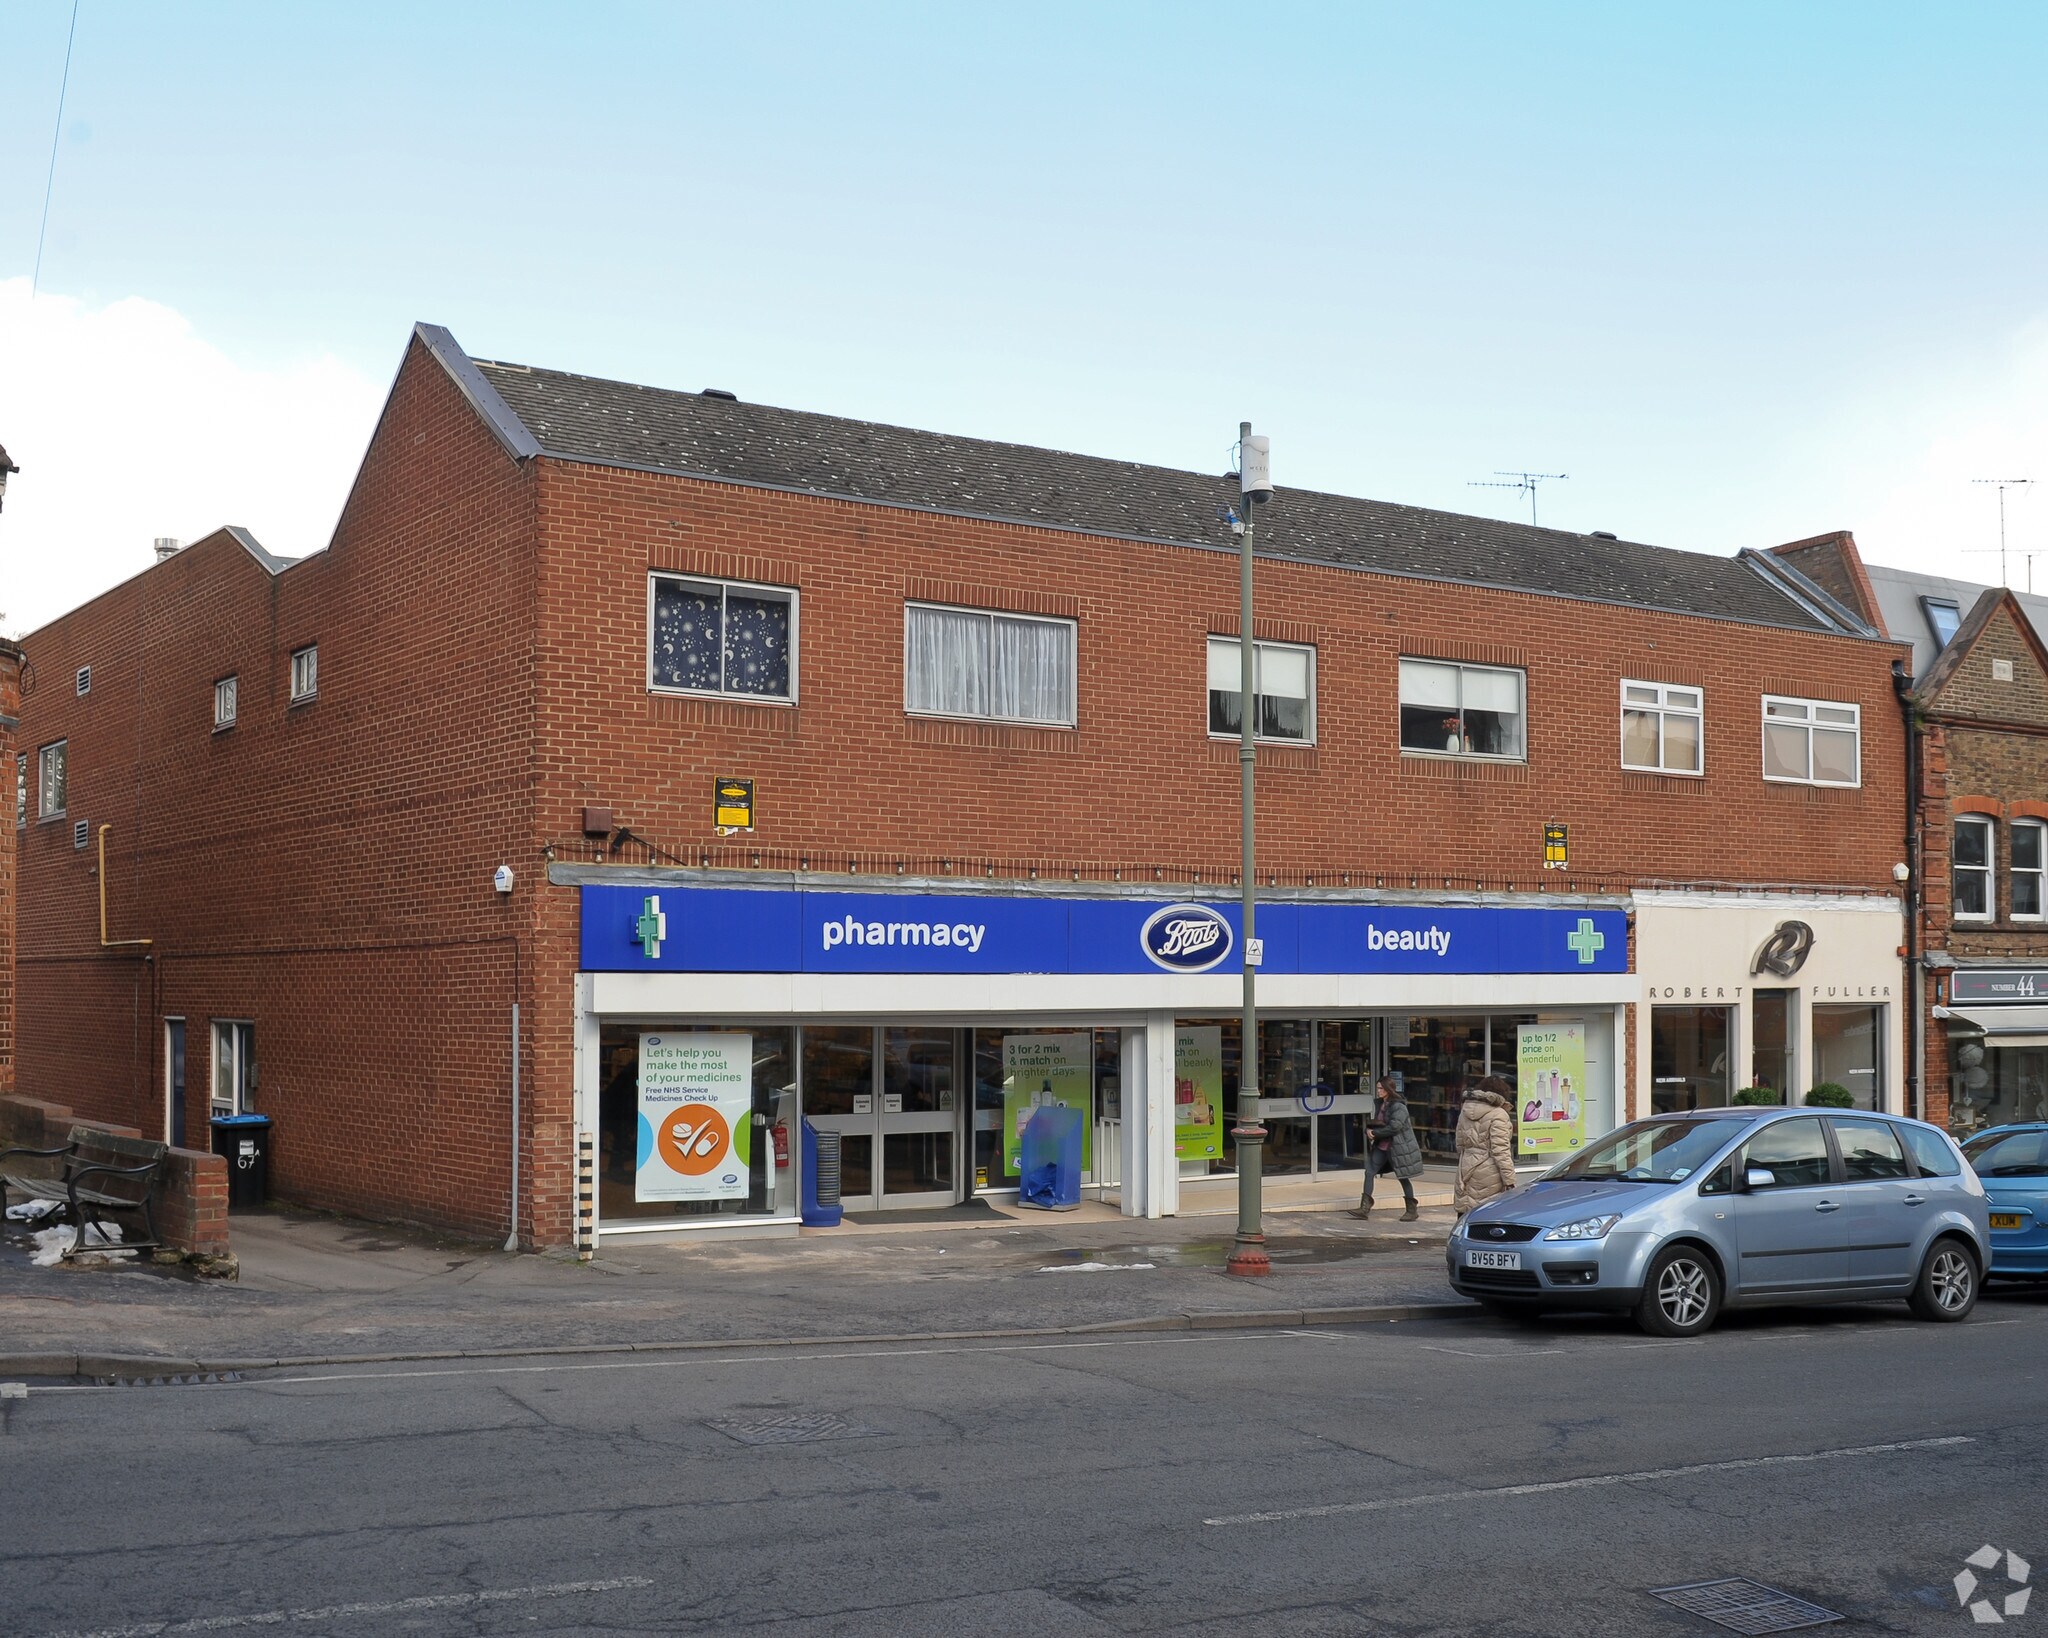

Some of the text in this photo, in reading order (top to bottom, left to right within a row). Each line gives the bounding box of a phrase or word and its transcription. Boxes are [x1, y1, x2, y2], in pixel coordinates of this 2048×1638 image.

[823, 915, 986, 953] pharmacy
[1157, 919, 1220, 956] Boots
[1367, 924, 1451, 956] beauty
[1991, 975, 2035, 996] NUMBER 44
[1649, 986, 1890, 998] ROBERT FULLER
[1178, 1036, 1194, 1046] mix
[1522, 1033, 1557, 1044] up to 1/2
[646, 1047, 722, 1060] Let's help you
[1009, 1043, 1061, 1055] 3 for 2 mix
[1187, 1048, 1200, 1057] on
[1522, 1044, 1555, 1054] price on
[1009, 1055, 1067, 1066] & match on
[1183, 1058, 1214, 1069] beauty
[1521, 1054, 1562, 1064] wonderful
[646, 1060, 728, 1070] make the most
[1010, 1066, 1076, 1079] brighter days
[645, 1072, 742, 1085] of your medicines
[645, 1086, 709, 1094] Free NHS Service
[684, 1094, 707, 1102] Check
[708, 1094, 719, 1103] Up
[1471, 1252, 1516, 1268] BV56 BFY
